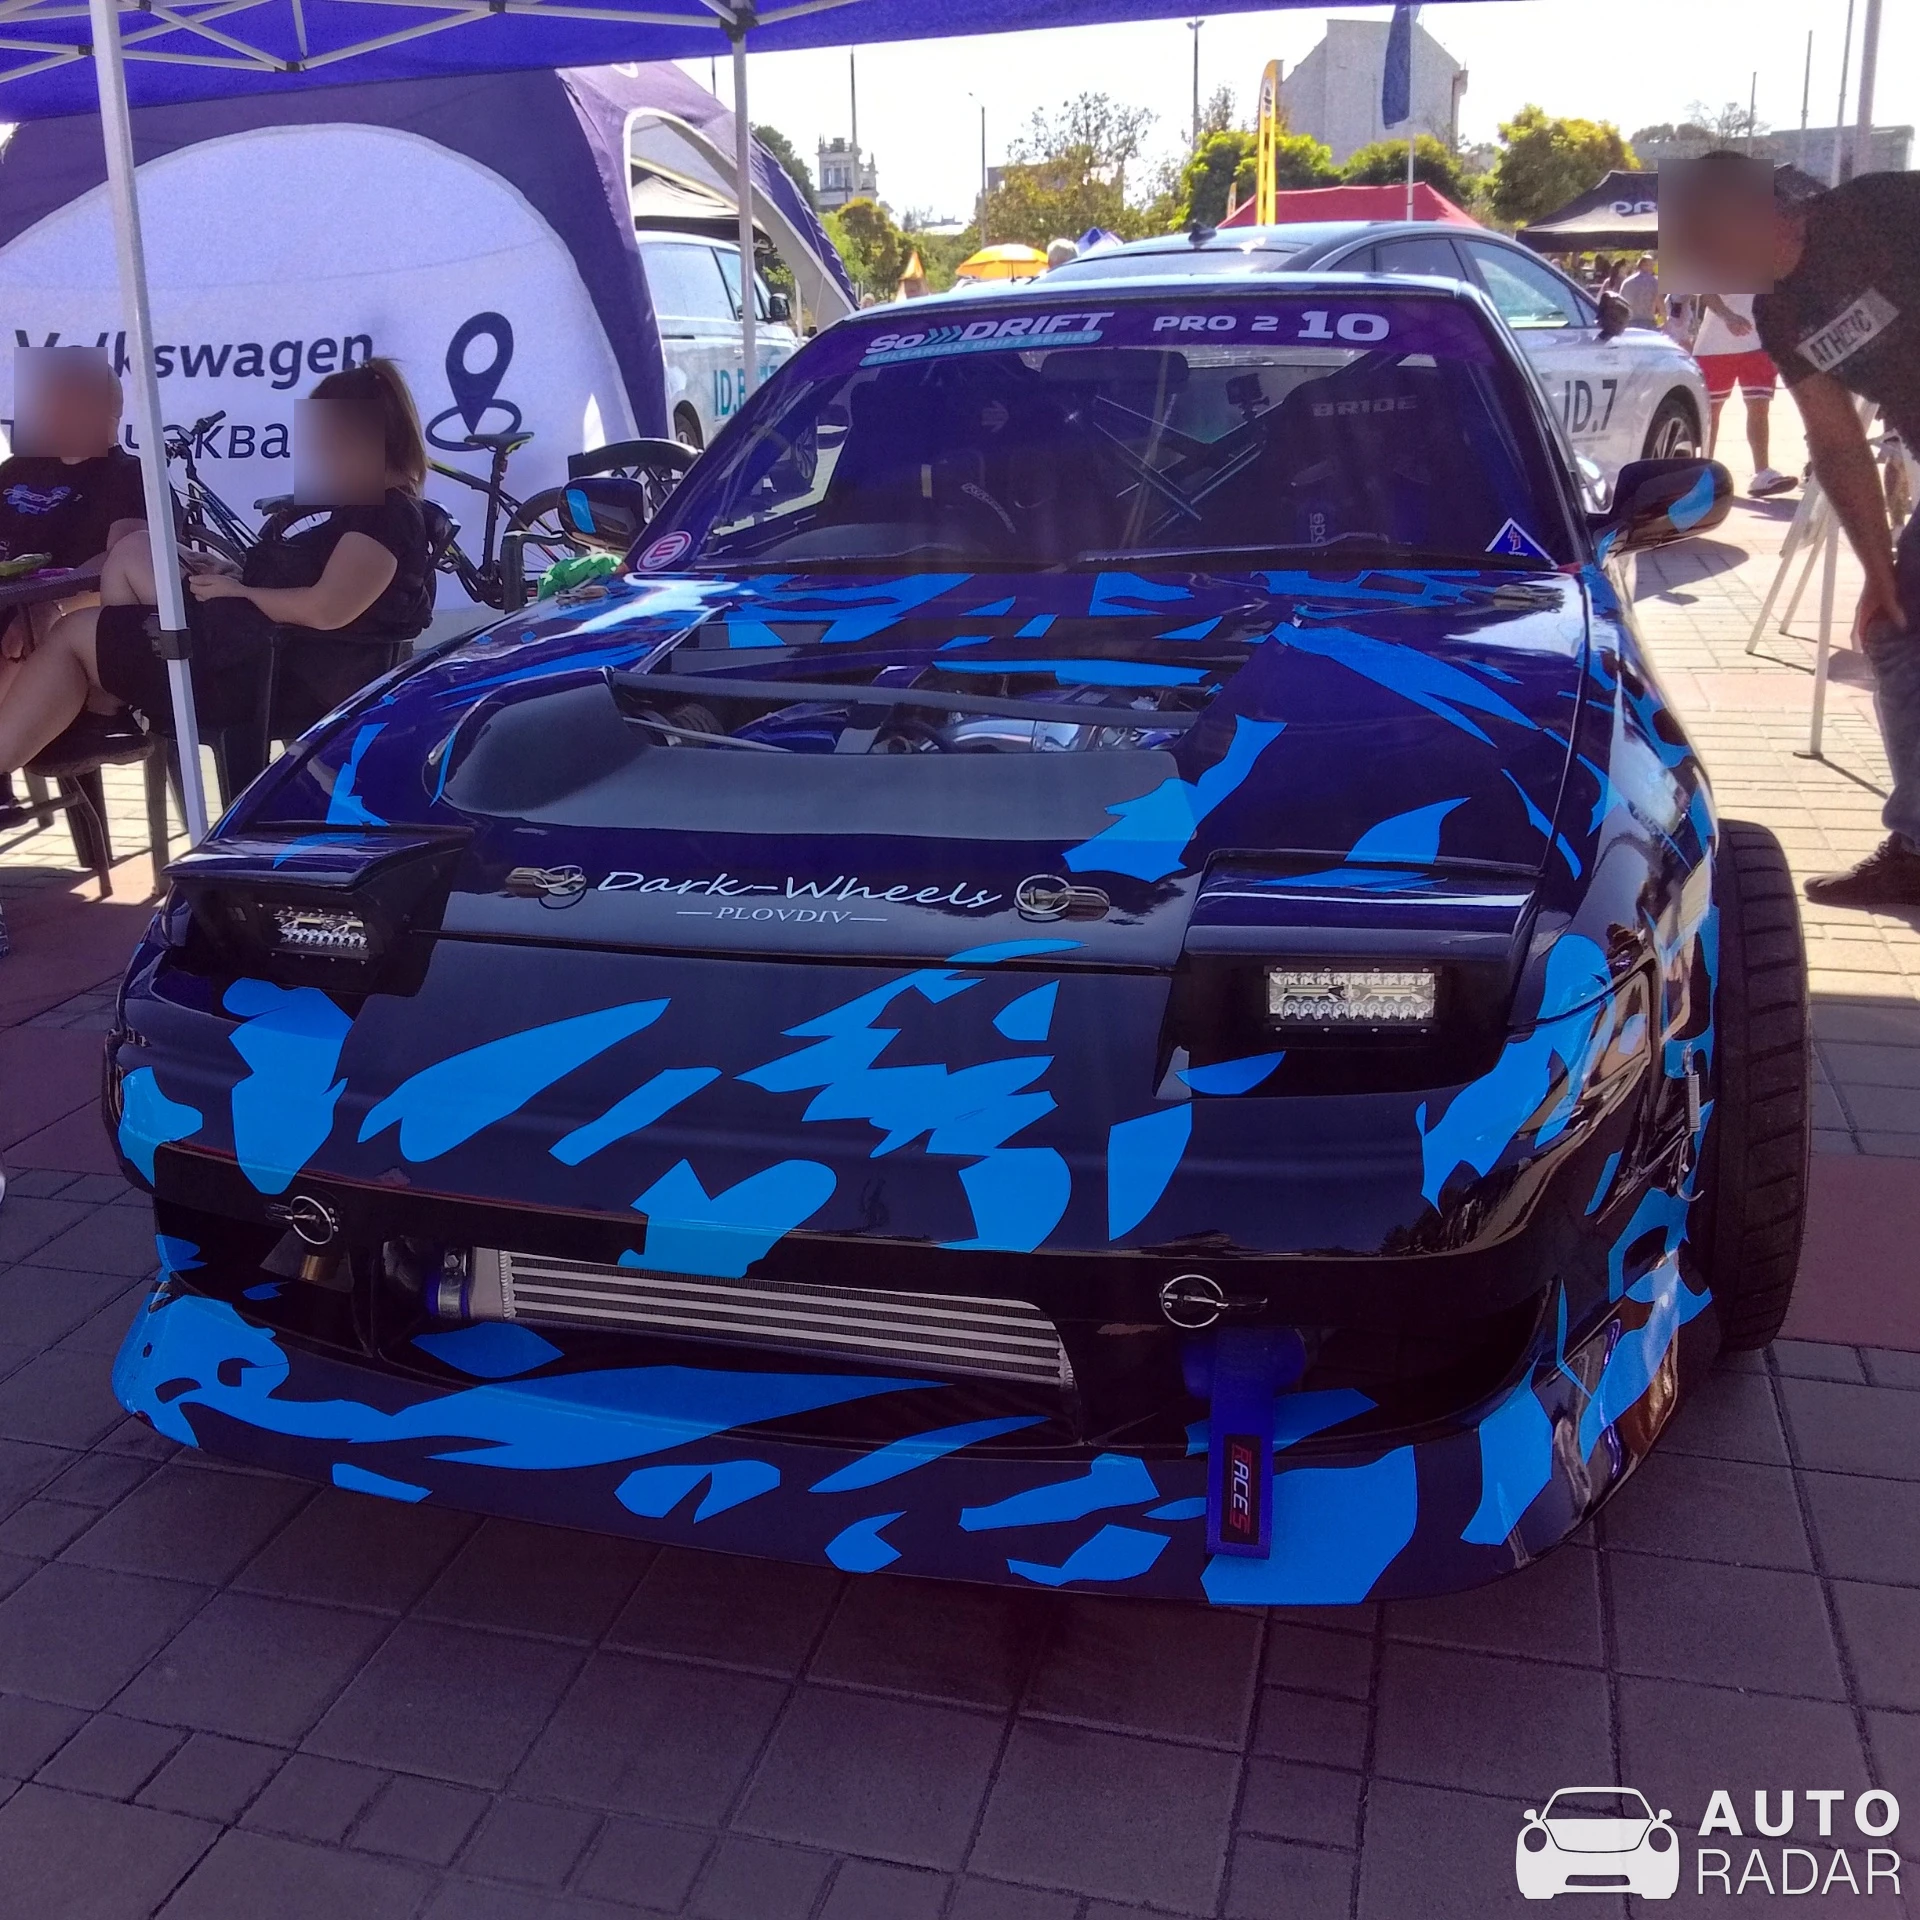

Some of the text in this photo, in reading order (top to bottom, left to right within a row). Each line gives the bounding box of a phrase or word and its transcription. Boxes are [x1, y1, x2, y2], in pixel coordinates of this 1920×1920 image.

[959, 312, 1115, 342] DRIFT
[971, 336, 1022, 351] DRIFT
[1027, 331, 1098, 345] SERIES
[1152, 310, 1390, 342] PRO 2 10
[1311, 395, 1418, 417] BRIDE
[1562, 378, 1618, 433] ID.7
[597, 871, 1003, 908] Dark-Wheels
[715, 906, 852, 923] PLOVDIV
